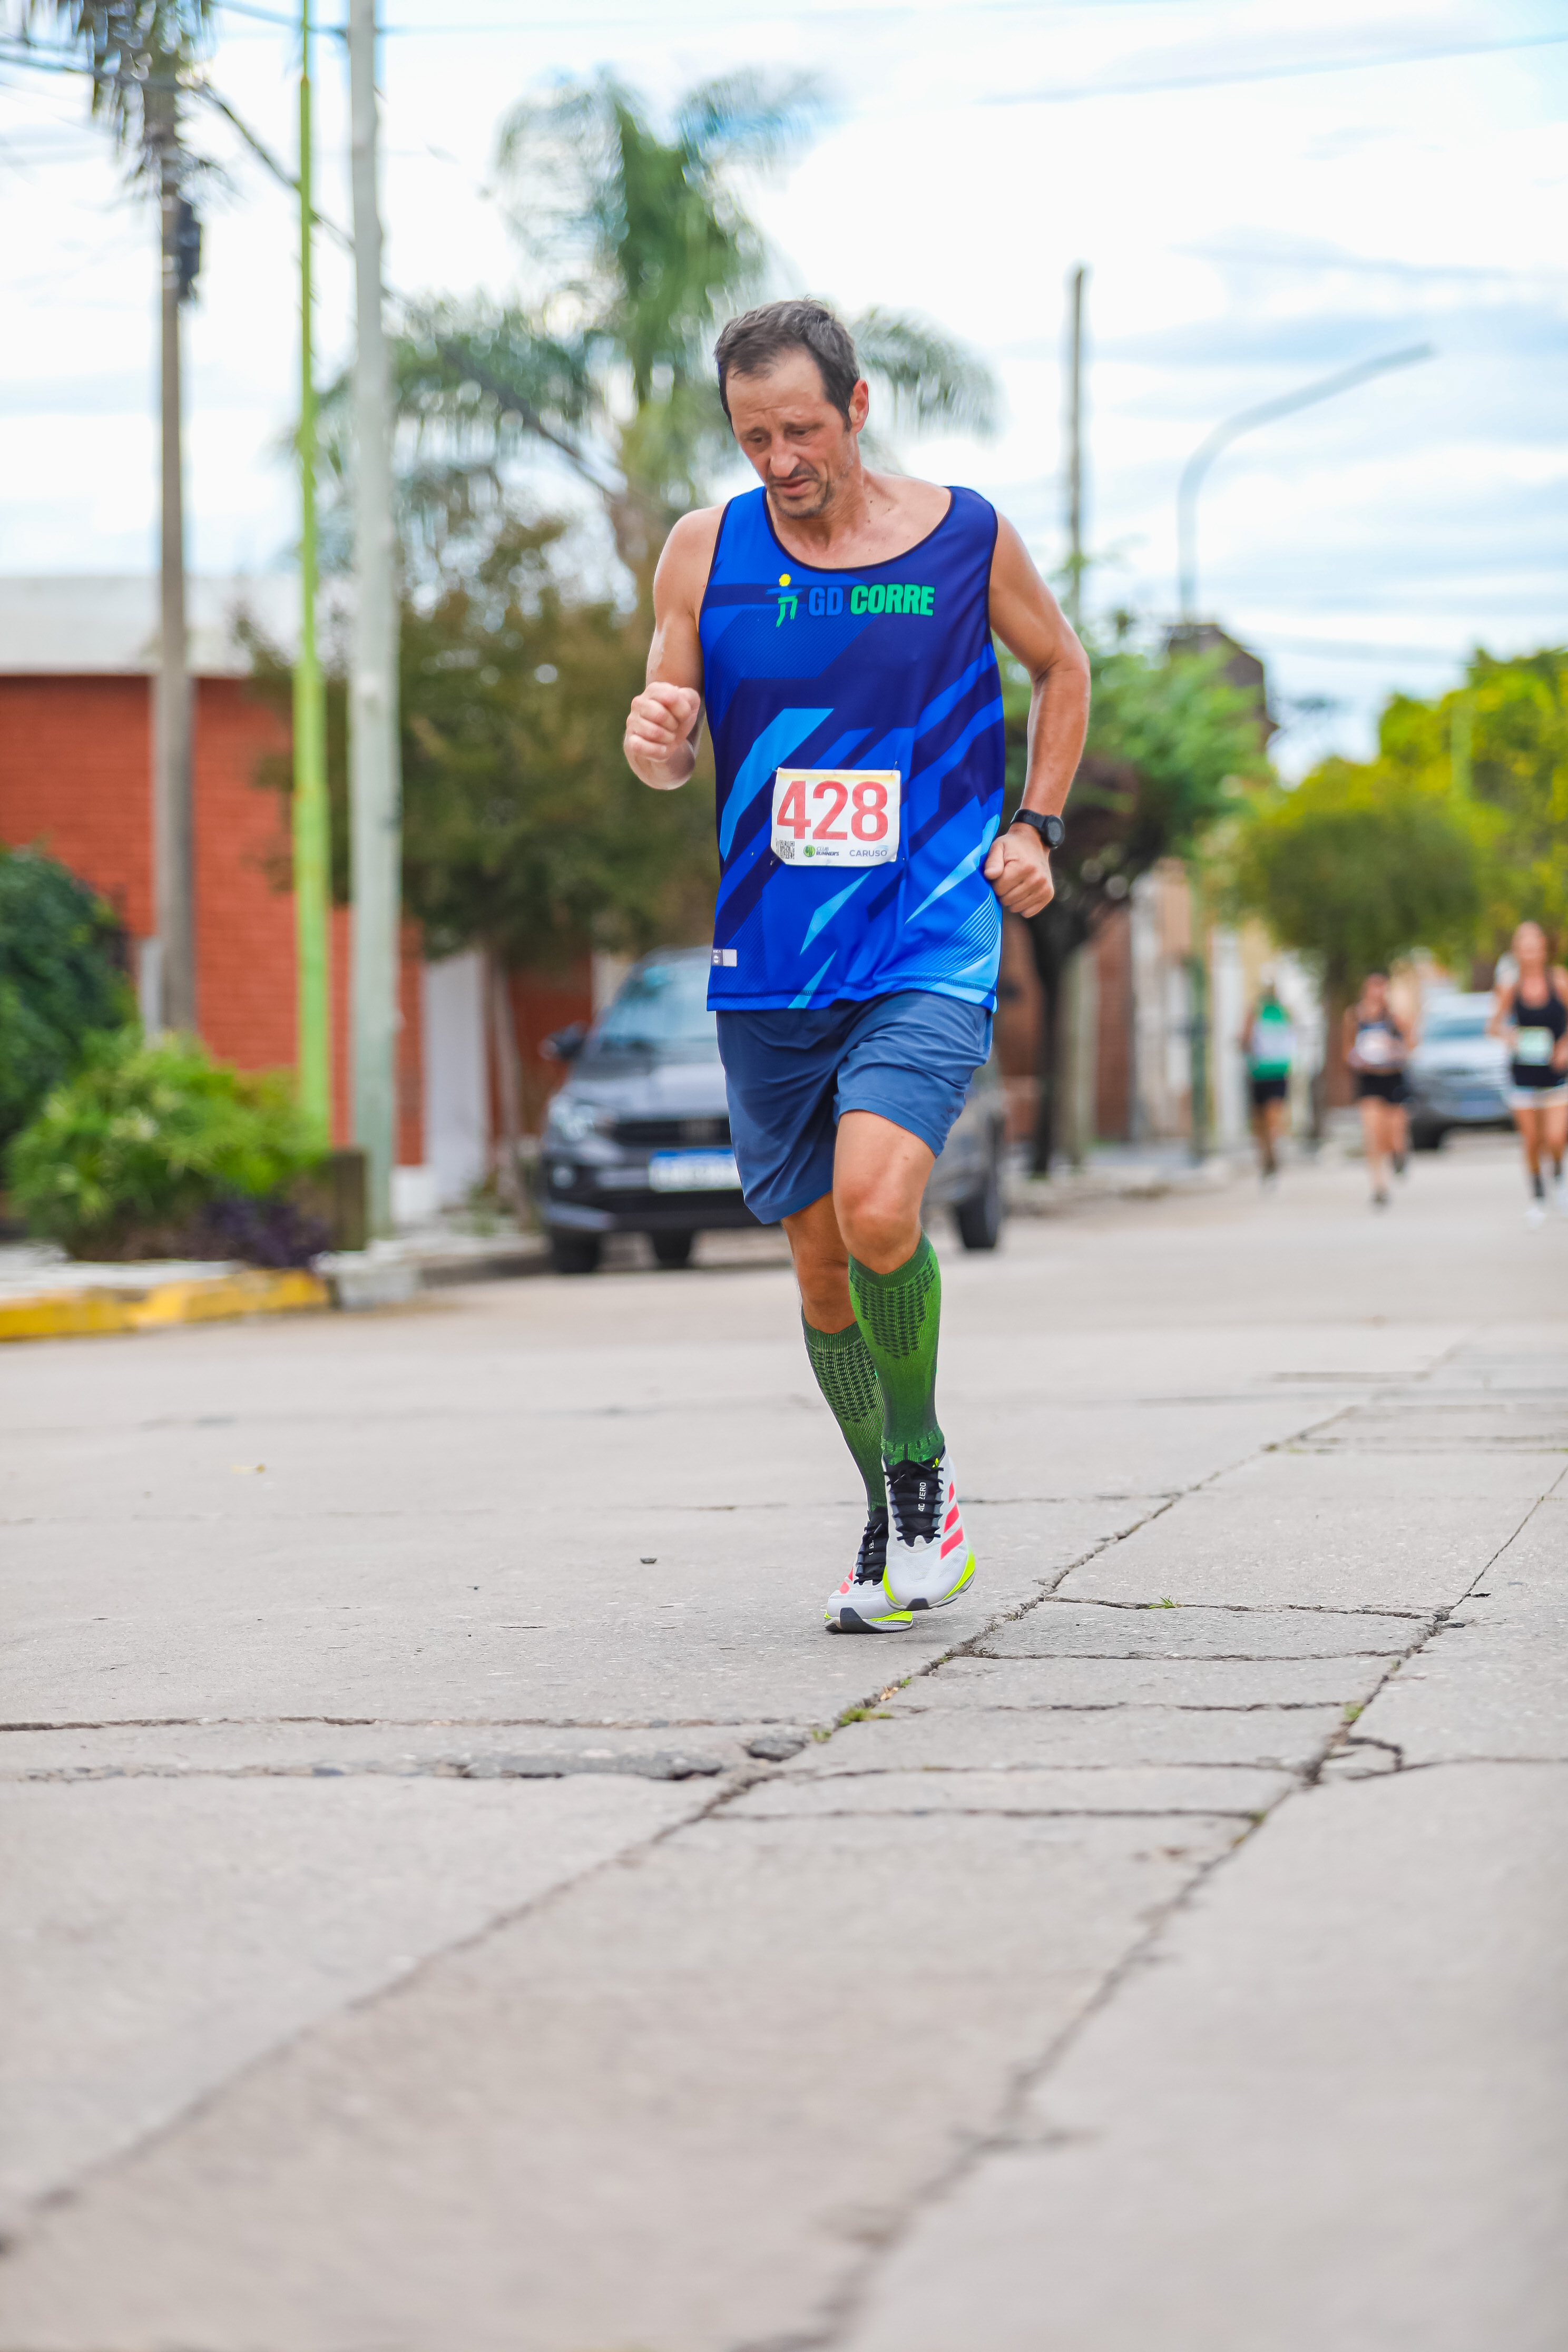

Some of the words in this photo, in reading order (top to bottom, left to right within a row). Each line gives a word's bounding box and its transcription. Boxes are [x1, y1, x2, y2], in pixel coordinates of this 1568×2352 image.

[809, 586, 843, 616] GD
[850, 584, 935, 616] CORRE
[777, 780, 888, 841] 428
